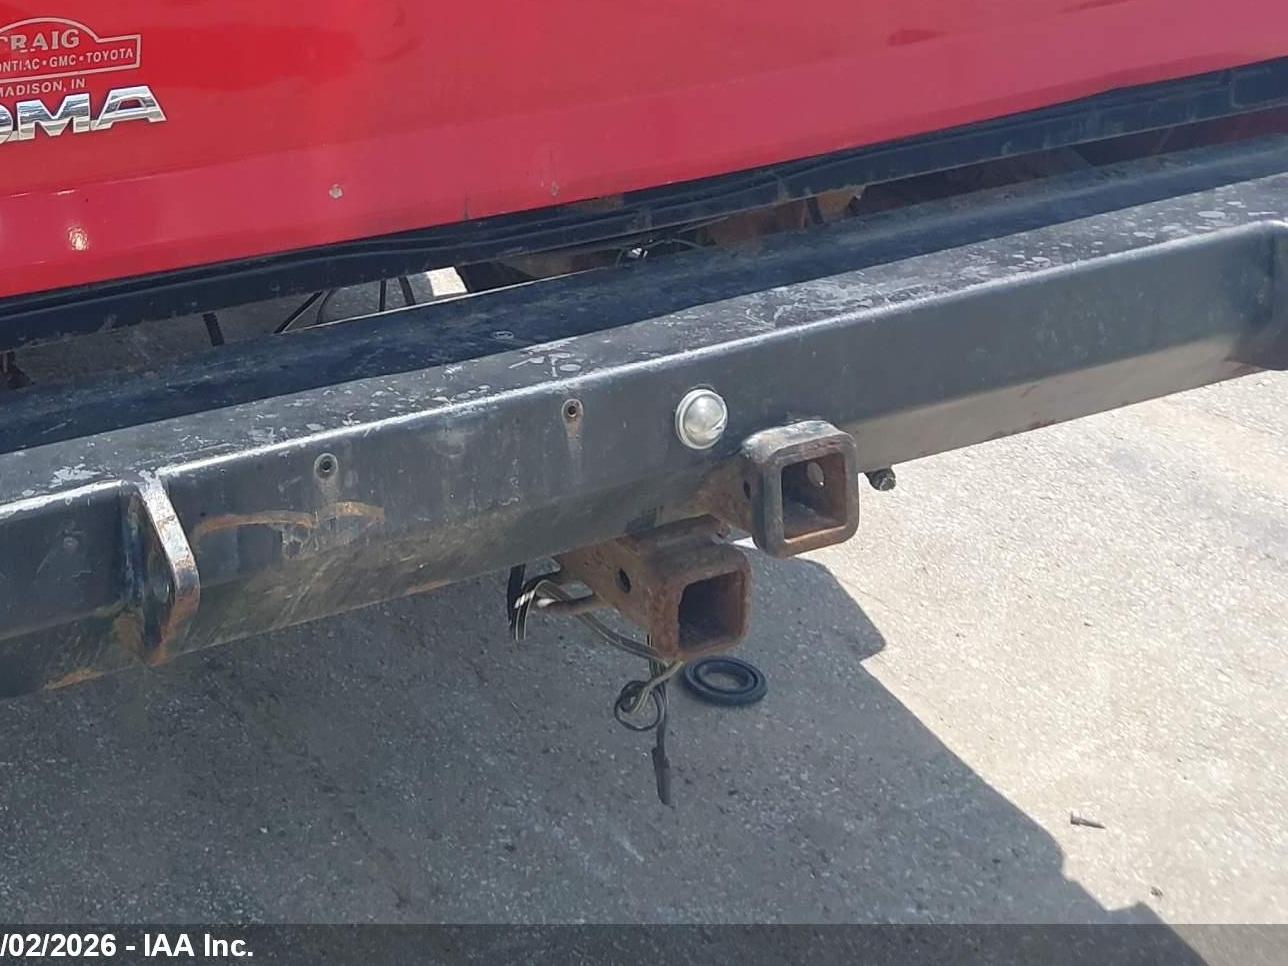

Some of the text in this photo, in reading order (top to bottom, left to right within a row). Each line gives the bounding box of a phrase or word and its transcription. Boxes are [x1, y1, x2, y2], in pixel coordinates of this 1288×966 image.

[49, 54, 77, 68] GMC
[85, 46, 134, 65] TOYOTA
[71, 78, 86, 89] IN
